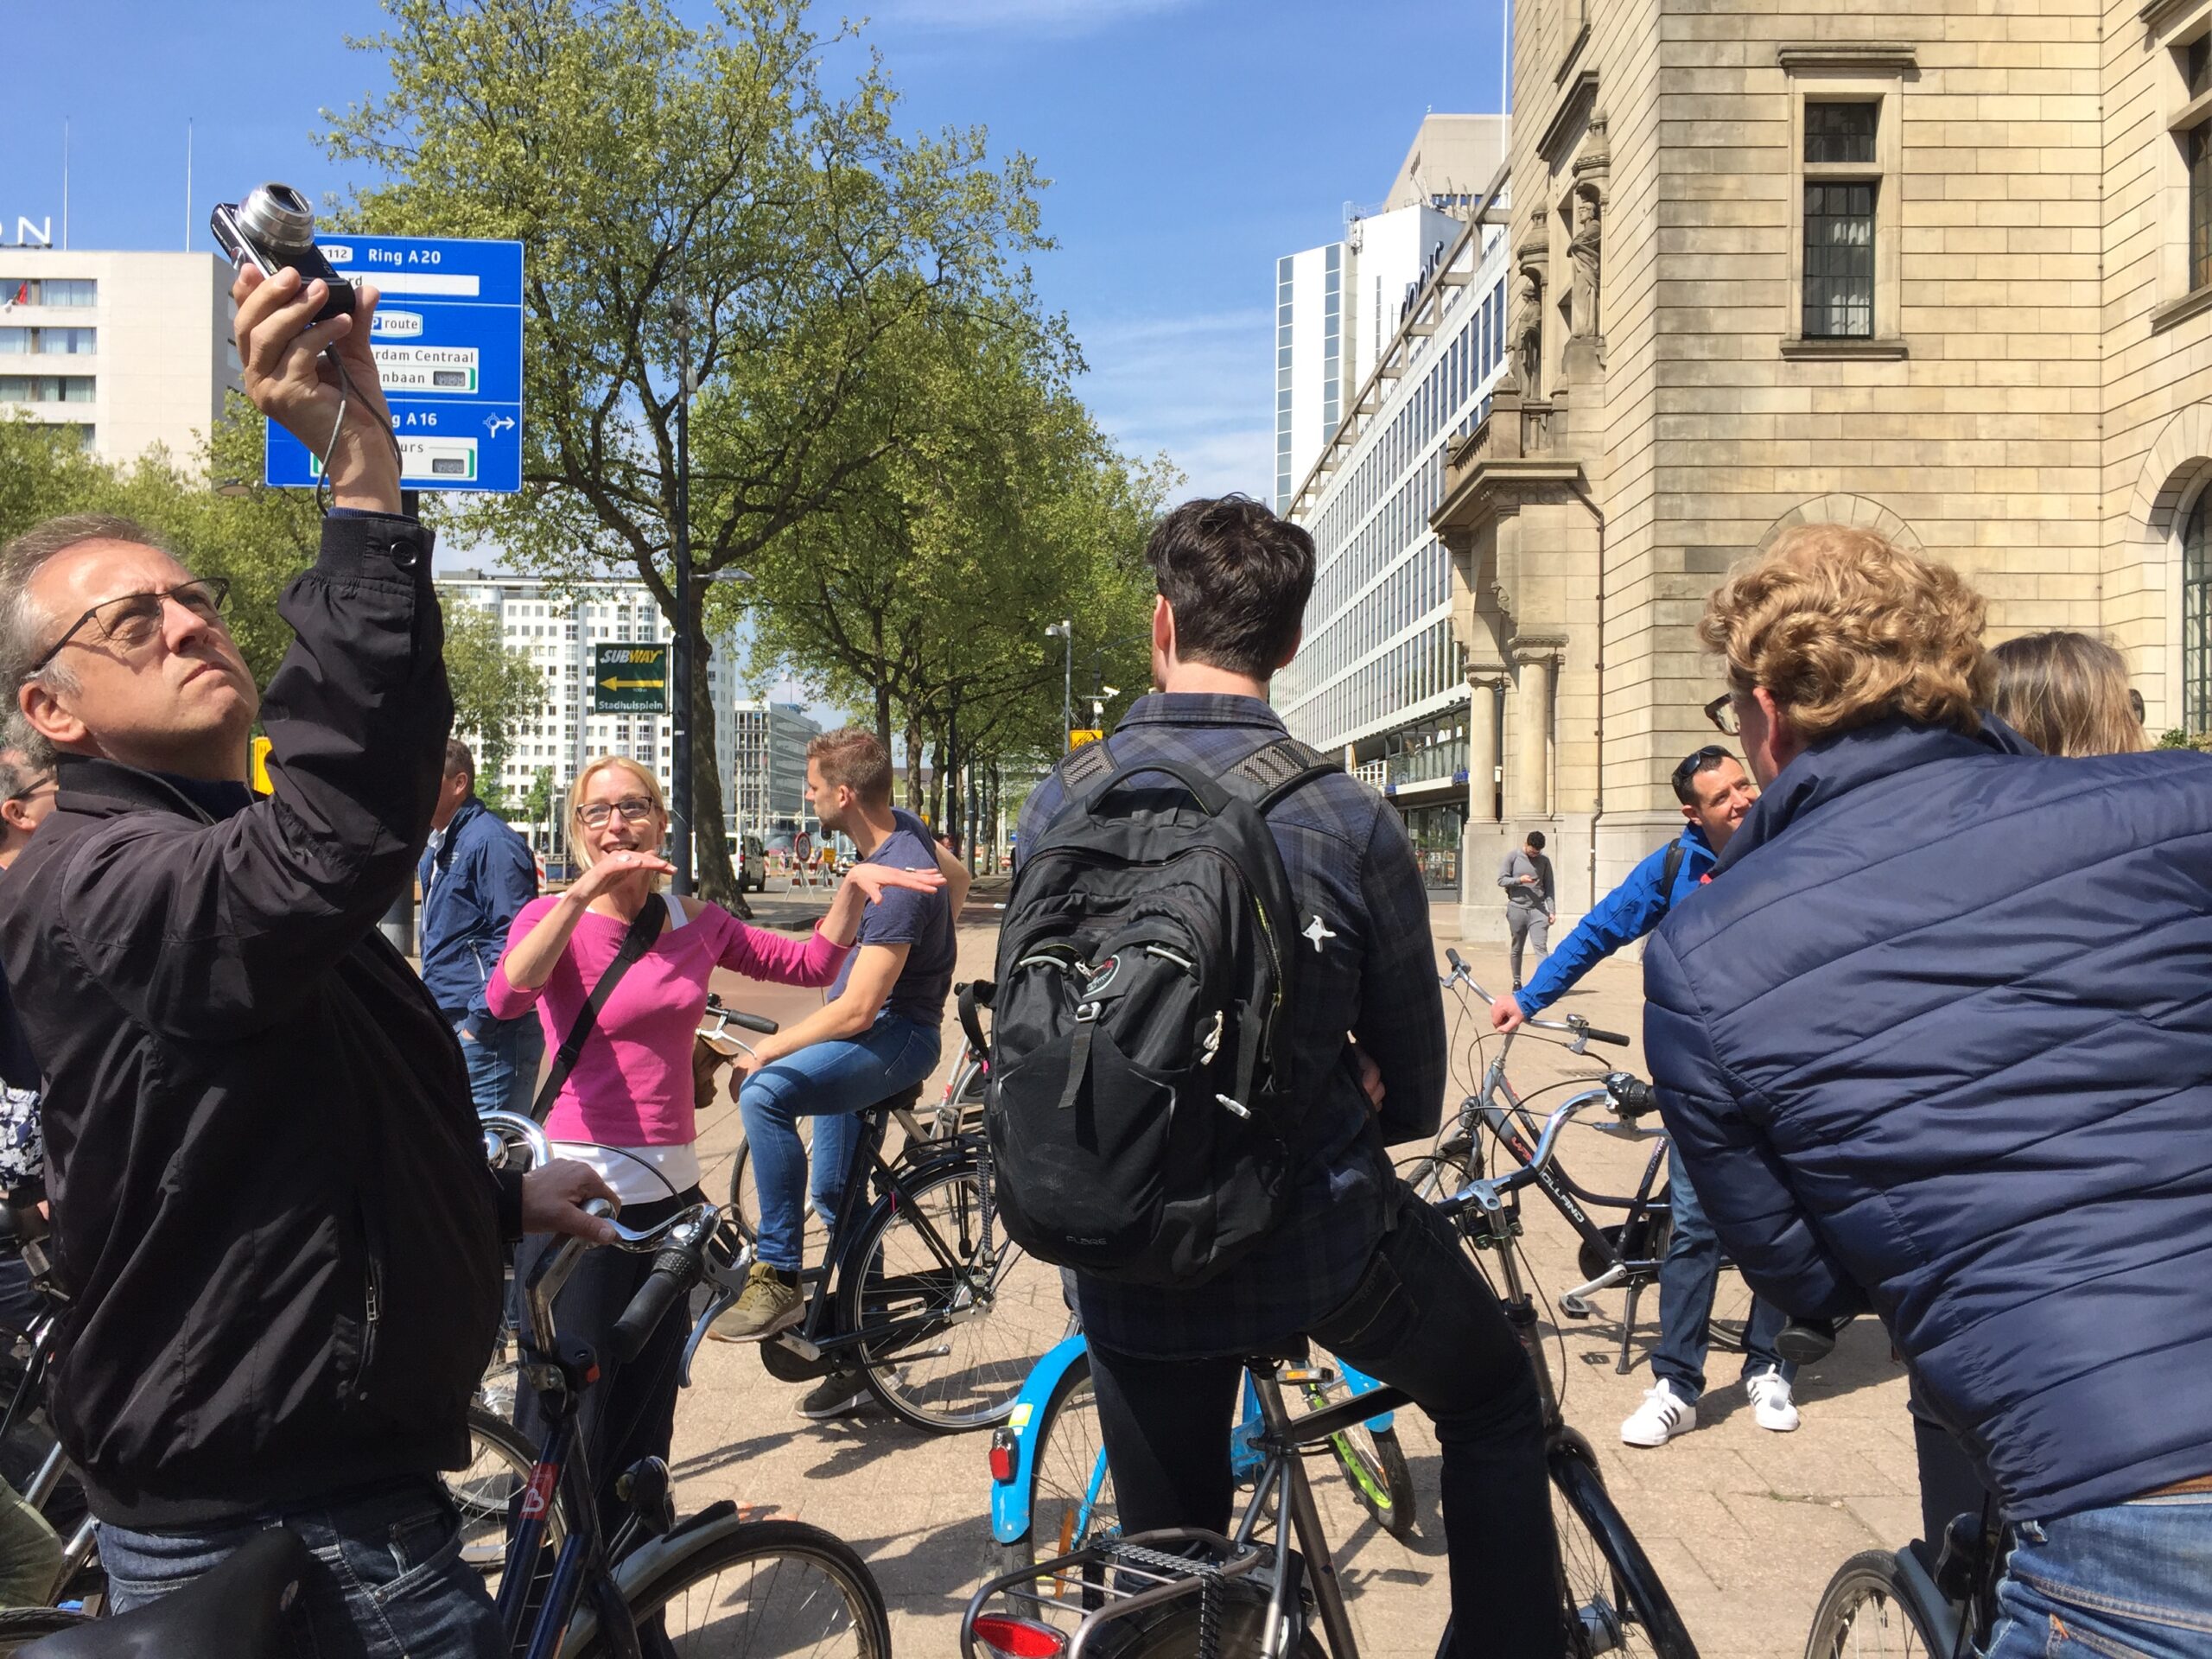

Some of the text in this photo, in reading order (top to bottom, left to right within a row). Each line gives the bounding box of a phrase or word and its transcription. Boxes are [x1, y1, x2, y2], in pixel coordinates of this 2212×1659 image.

[328, 249, 347, 258] 112
[368, 249, 442, 265] Ring A20
[385, 319, 418, 329] route
[375, 349, 474, 363] rdam Centraal
[380, 371, 425, 384] nbaan
[406, 412, 437, 426] A16
[400, 443, 423, 453] urs
[600, 650, 664, 664] SUBWAY
[599, 701, 664, 711] Stadhuisplein
